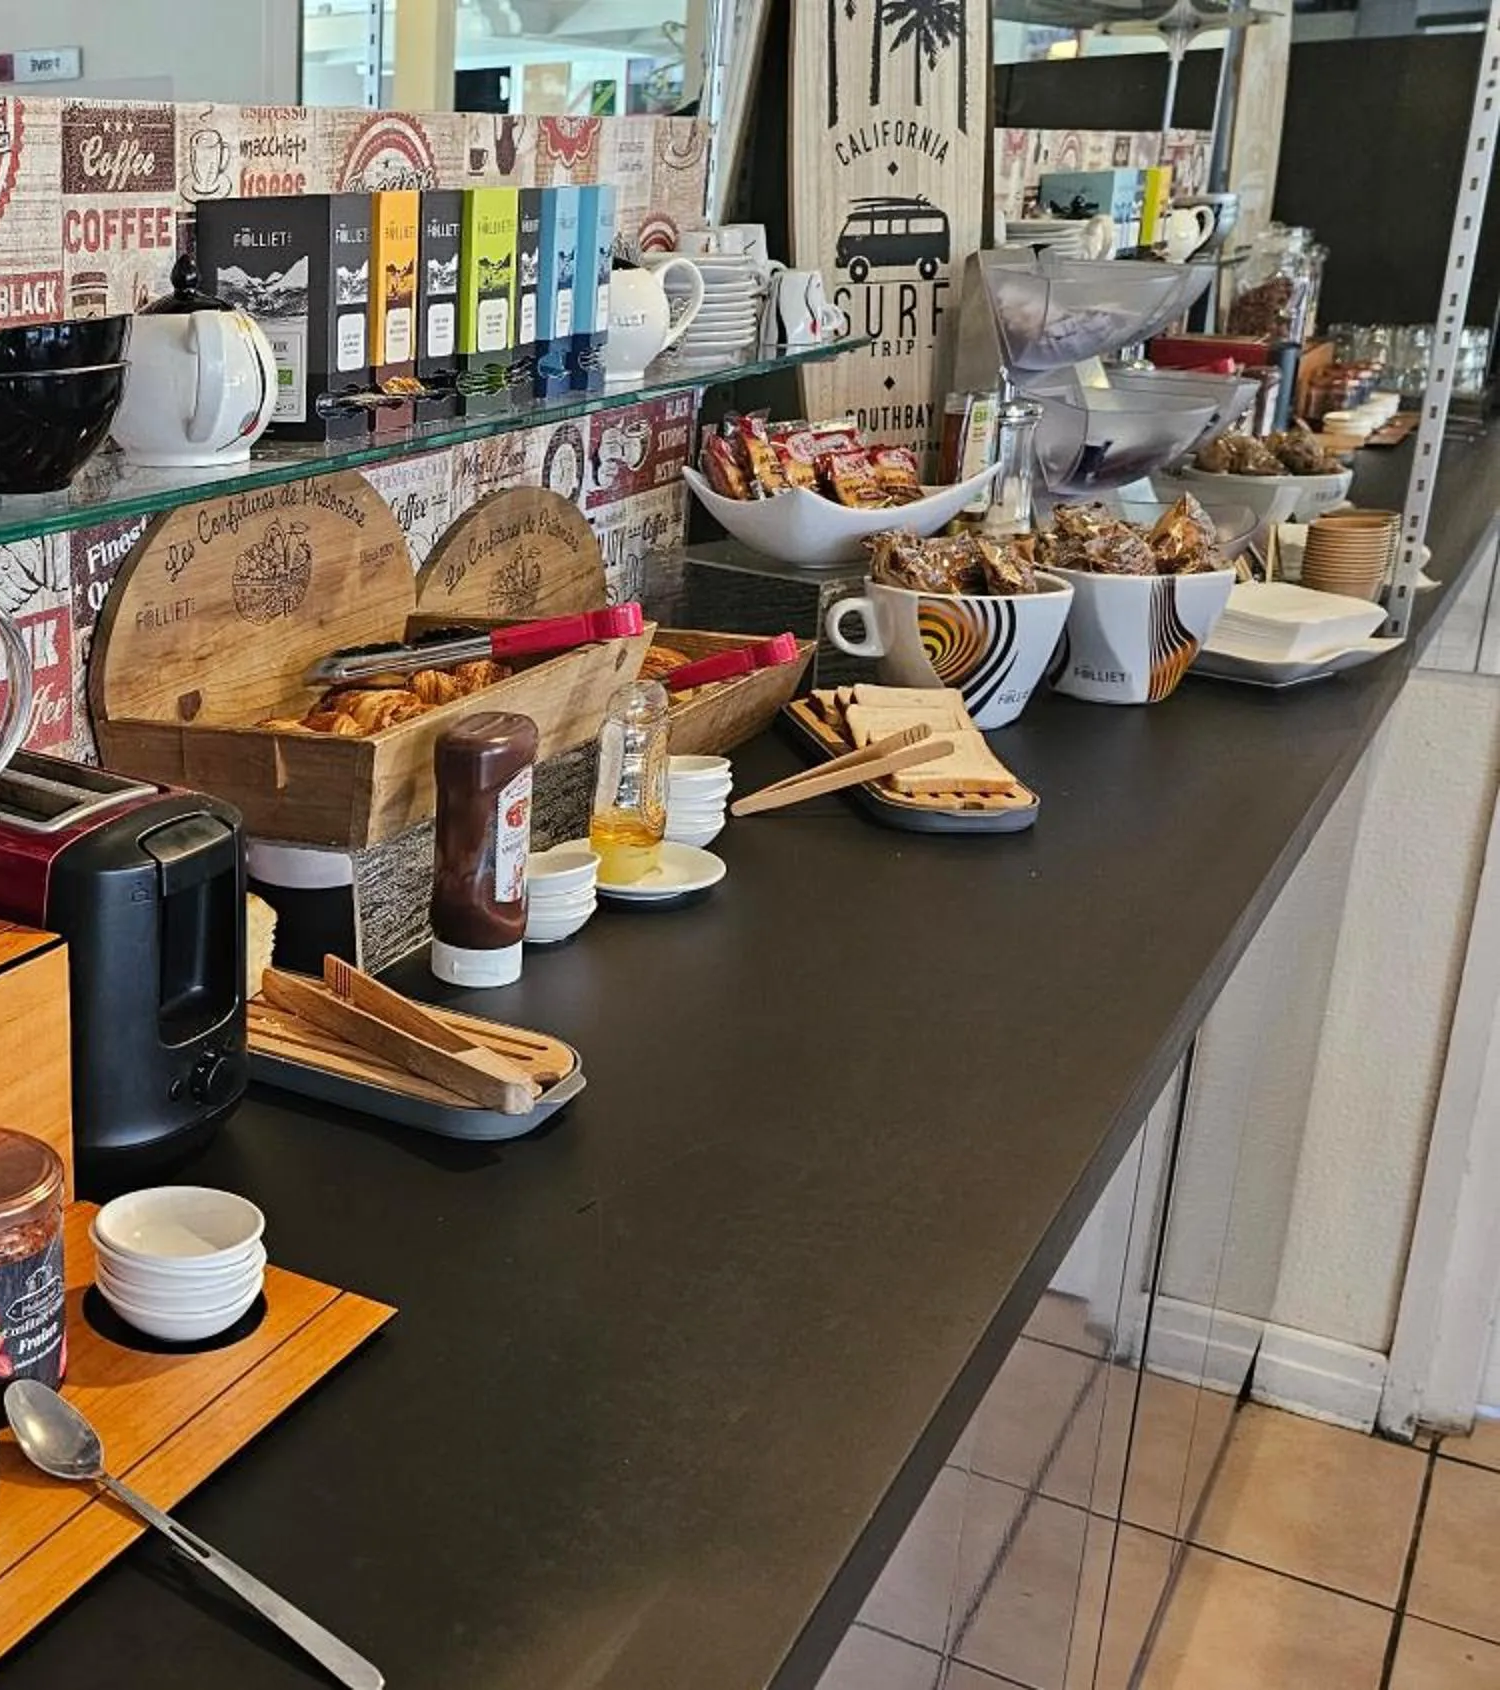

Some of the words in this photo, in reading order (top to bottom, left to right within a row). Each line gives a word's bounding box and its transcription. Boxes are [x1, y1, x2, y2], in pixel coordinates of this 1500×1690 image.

[79, 134, 156, 189] Coffee
[836, 119, 950, 167] CALIFORNIA
[65, 206, 173, 254] COFFEE
[834, 281, 951, 340] SURF
[870, 340, 916, 358] TRIP
[844, 401, 936, 433] OUTHBAY
[165, 540, 196, 583] Les
[197, 489, 274, 545] Confitures
[280, 486, 299, 506] de
